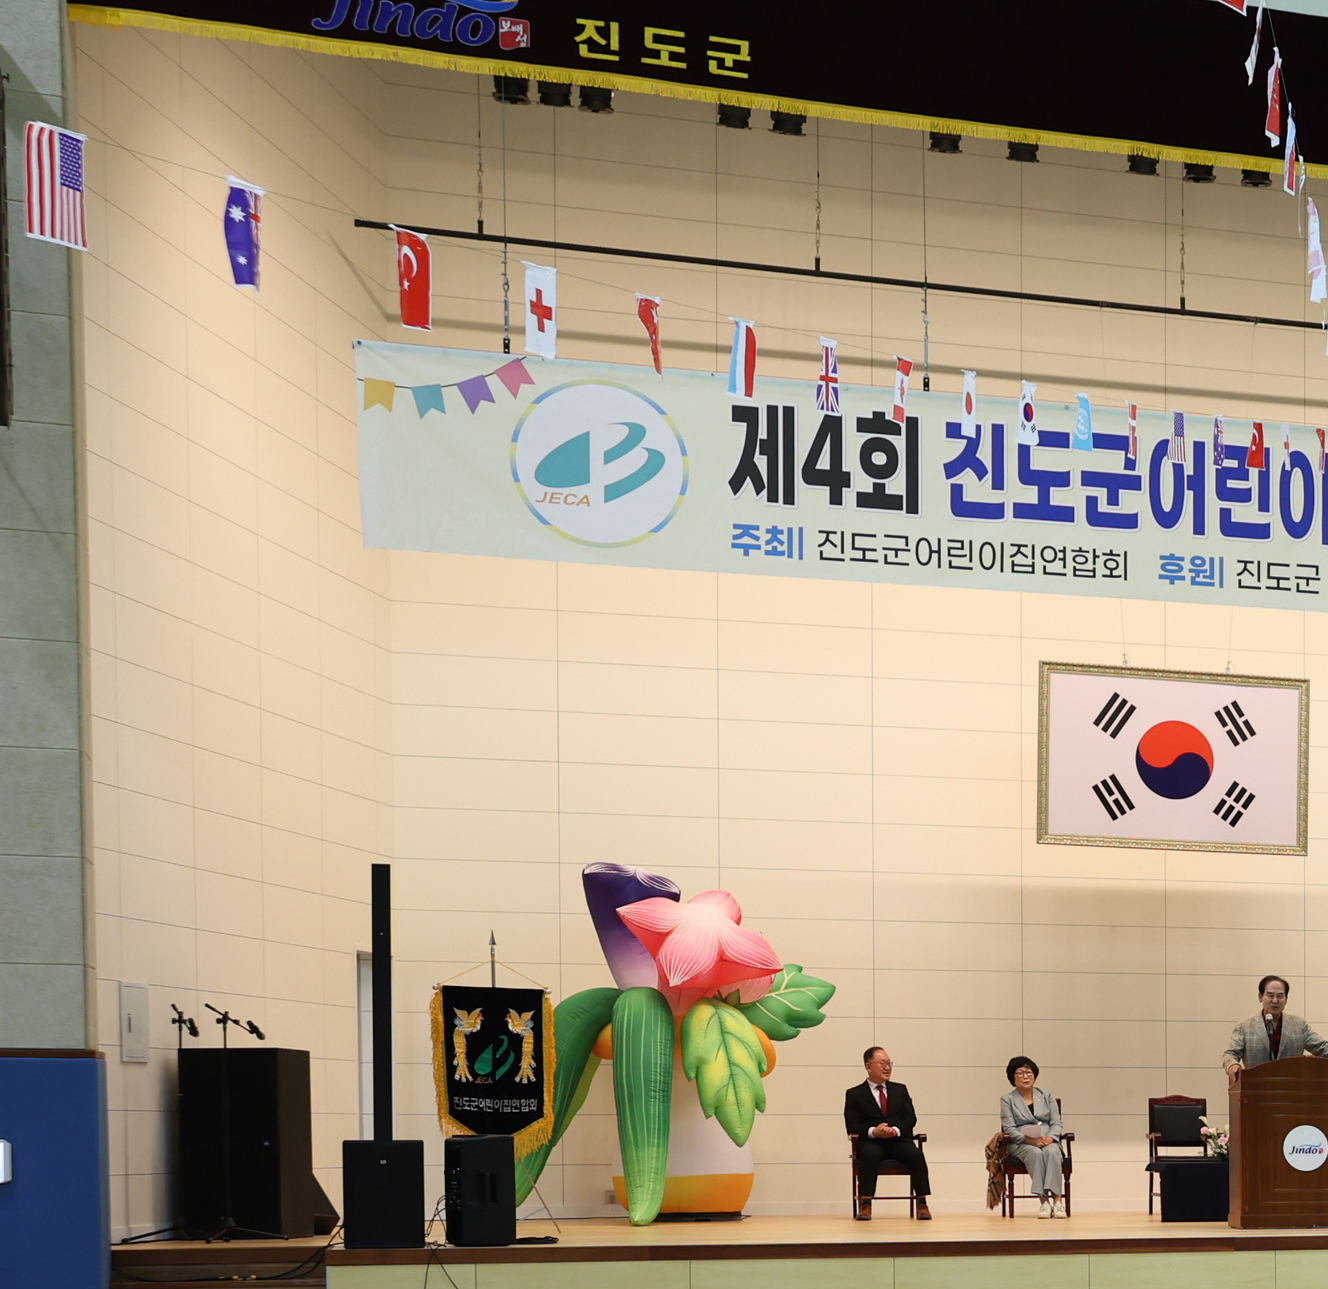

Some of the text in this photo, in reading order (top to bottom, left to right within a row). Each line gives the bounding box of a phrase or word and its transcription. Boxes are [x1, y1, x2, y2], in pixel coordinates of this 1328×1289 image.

[311, 0, 496, 46] Jindo
[573, 17, 752, 79] 진도군
[728, 404, 920, 515] 제4회
[535, 491, 592, 507] JECA
[816, 528, 1129, 581] 진도군어린이집연합회
[1235, 558, 1321, 594] 진도군
[1288, 1145, 1318, 1156] Jindo
